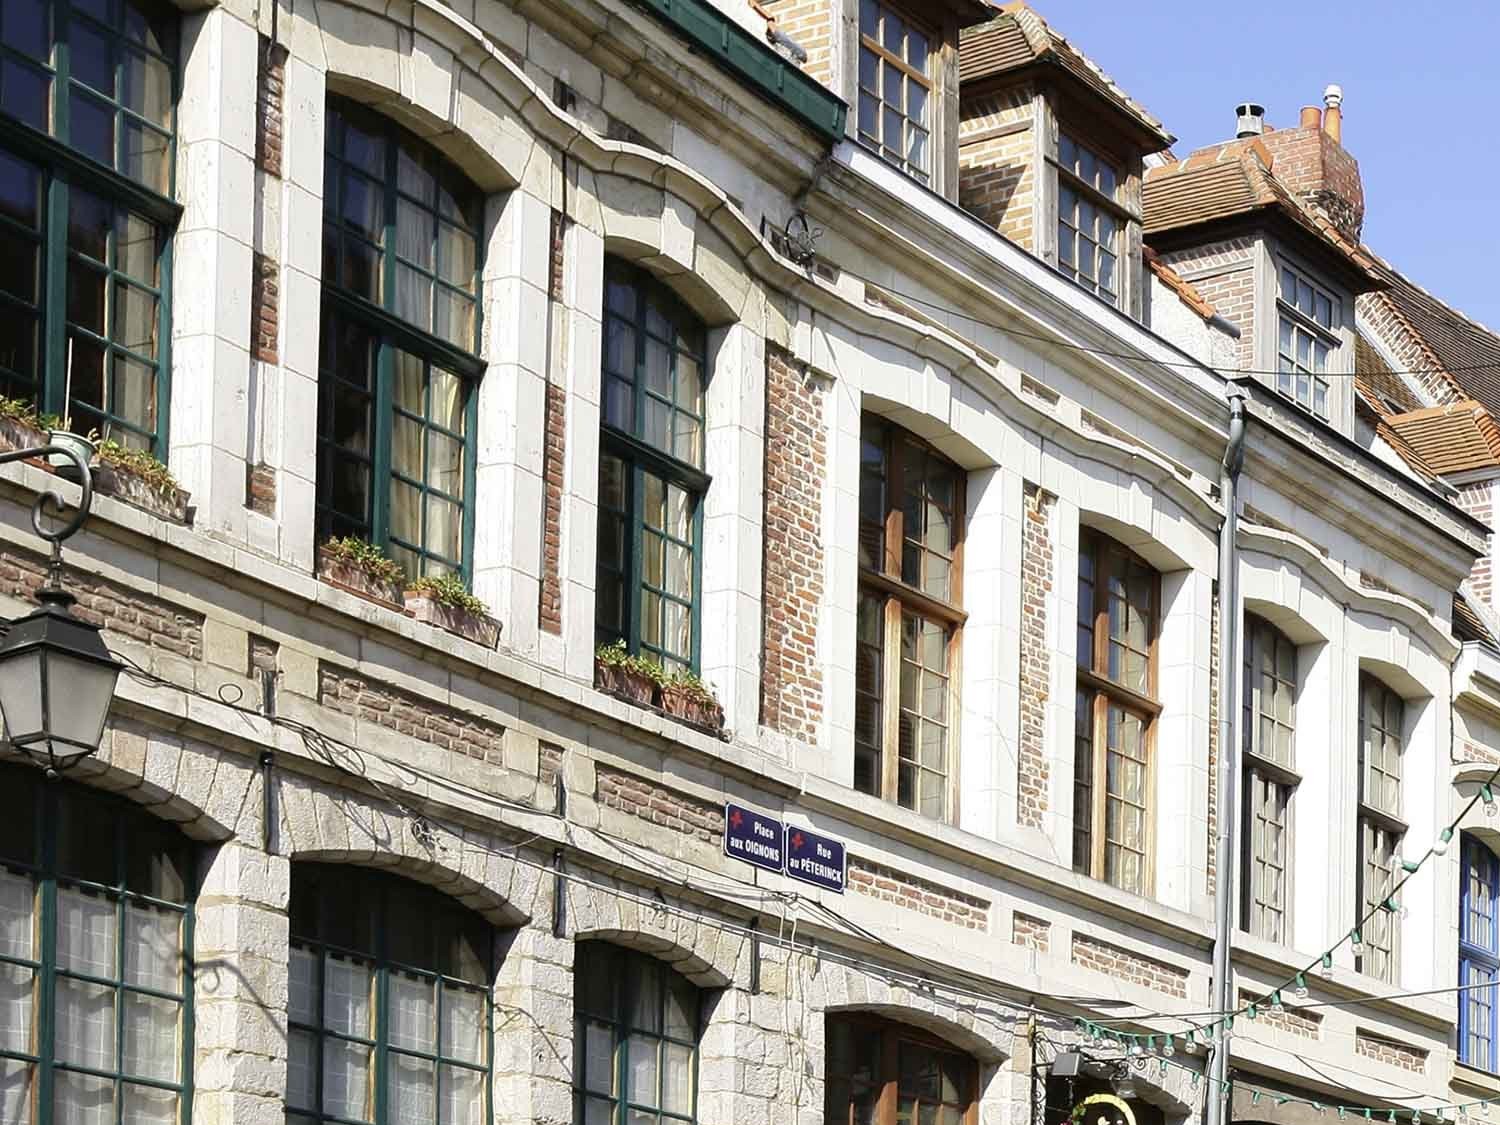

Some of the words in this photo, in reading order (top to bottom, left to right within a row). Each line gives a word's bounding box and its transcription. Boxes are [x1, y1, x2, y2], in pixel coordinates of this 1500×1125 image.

[754, 822, 774, 840] Place
[730, 837, 743, 850] aux
[745, 839, 779, 862] OIGNONS
[817, 843, 832, 860] Rue
[790, 857, 800, 868] au
[801, 857, 842, 883] PÉTERINCK
